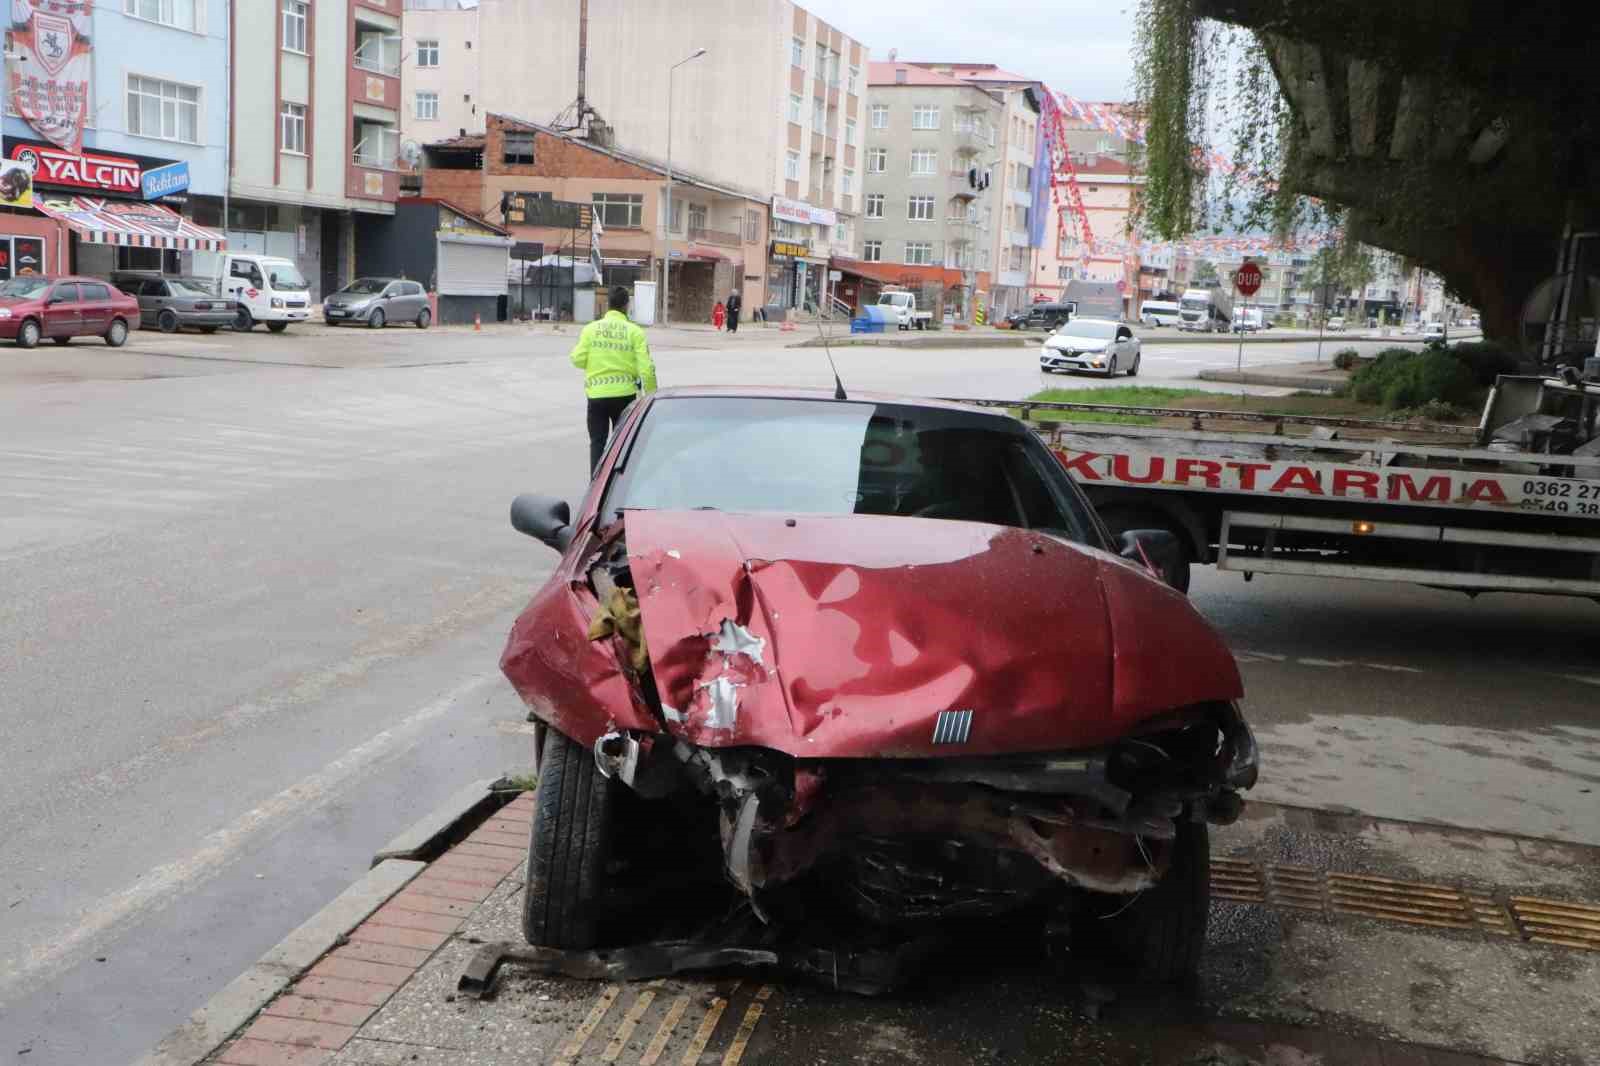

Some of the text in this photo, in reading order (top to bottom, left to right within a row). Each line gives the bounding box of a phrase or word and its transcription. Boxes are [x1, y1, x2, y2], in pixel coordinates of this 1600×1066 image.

[41, 156, 140, 188] YALÇIN
[148, 171, 188, 194] Reklam
[1238, 272, 1260, 286] DUR
[1054, 450, 1509, 505] KURTARMA
[1523, 480, 1570, 497] 0362
